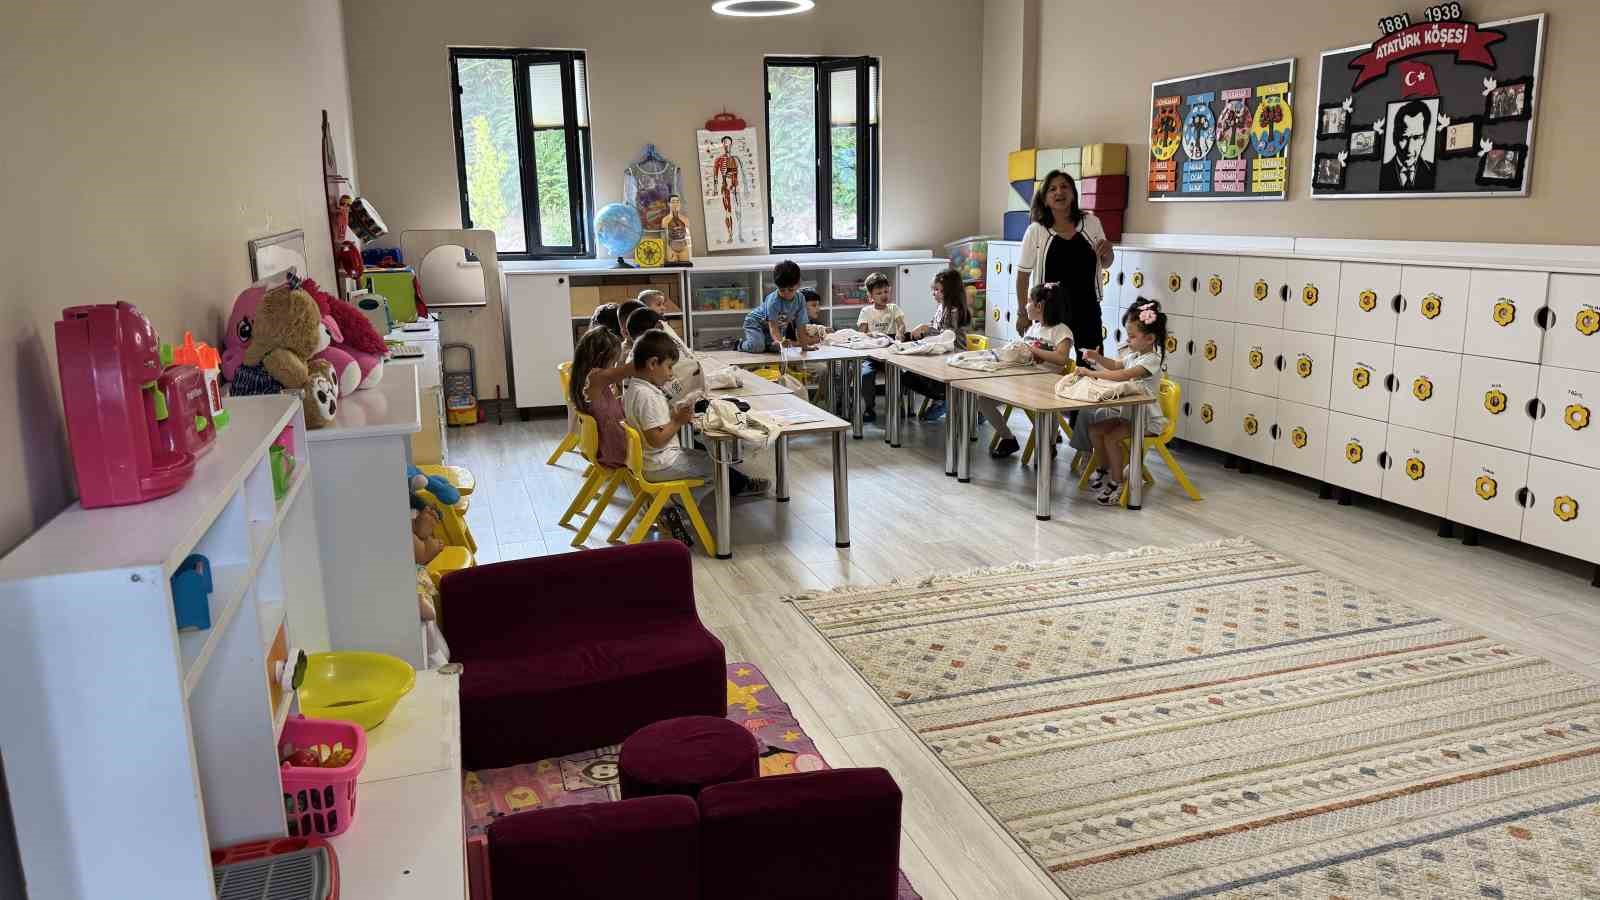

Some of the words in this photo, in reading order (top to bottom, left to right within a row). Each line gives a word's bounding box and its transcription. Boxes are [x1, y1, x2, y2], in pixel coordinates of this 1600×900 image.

[1379, 15, 1409, 34] 1881
[1425, 4, 1461, 22] 1938
[1376, 31, 1421, 60] ATATÜRK
[1424, 23, 1469, 48] KÖŞESİ
